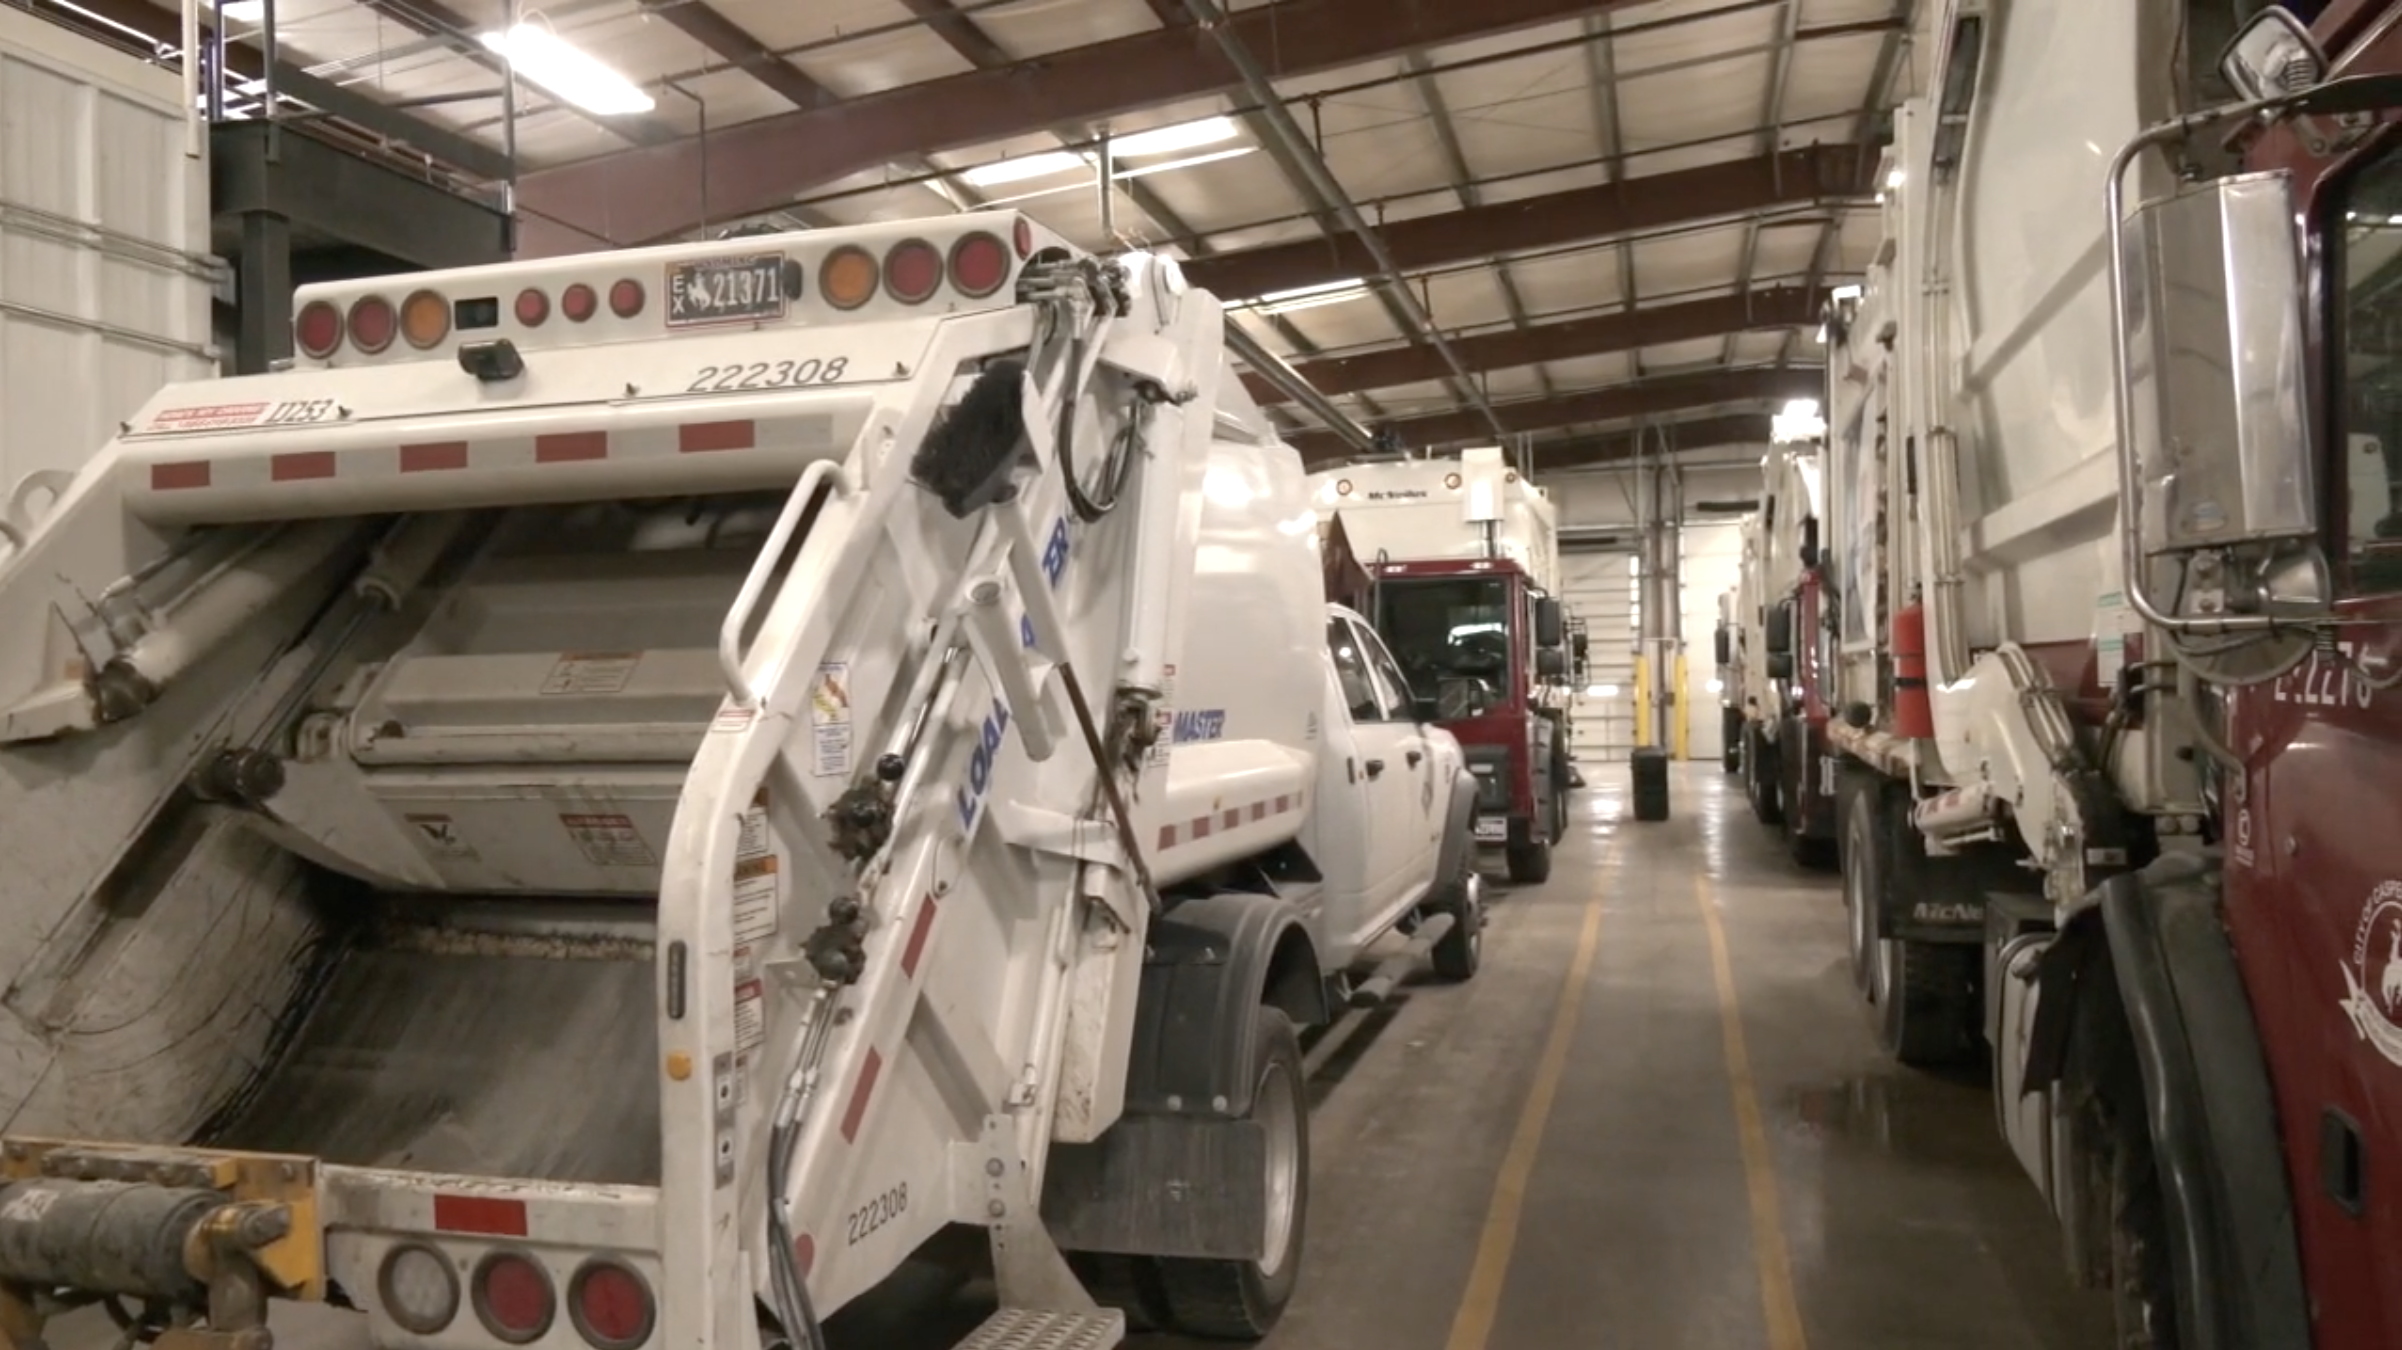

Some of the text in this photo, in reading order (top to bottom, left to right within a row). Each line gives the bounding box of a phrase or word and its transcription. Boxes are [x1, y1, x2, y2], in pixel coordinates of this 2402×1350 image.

[713, 267, 779, 307] 21371
[686, 355, 849, 392] 222308
[1173, 710, 1225, 744] MASTER
[848, 1181, 908, 1246] 222308
